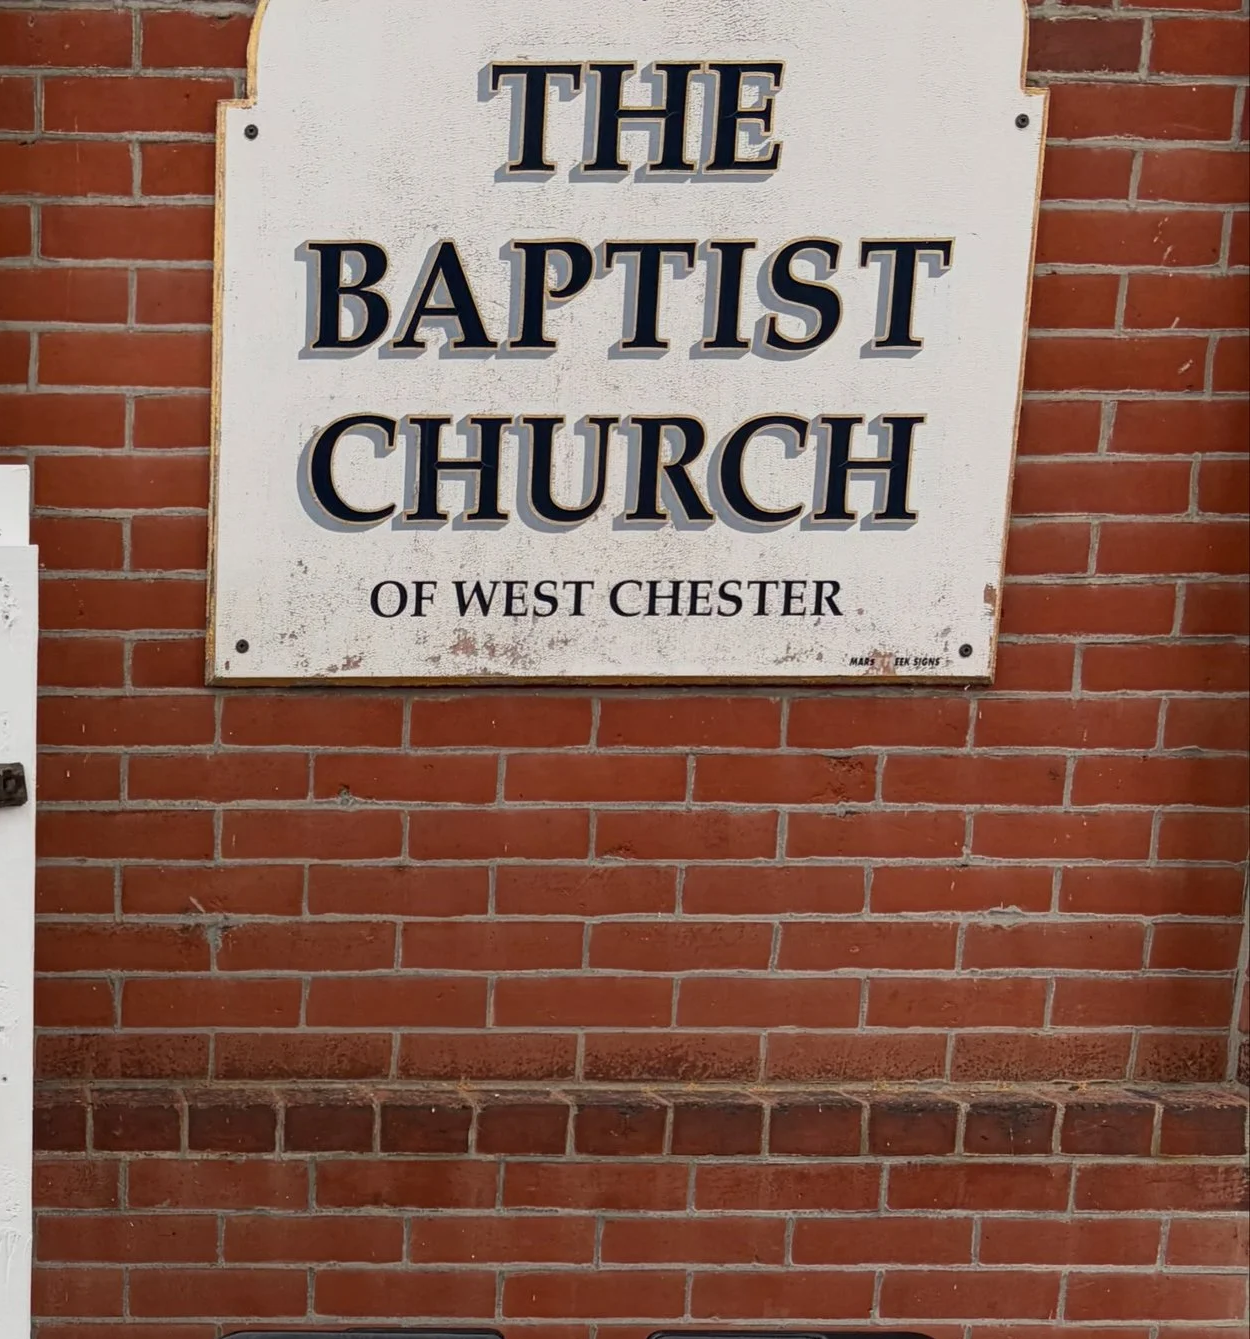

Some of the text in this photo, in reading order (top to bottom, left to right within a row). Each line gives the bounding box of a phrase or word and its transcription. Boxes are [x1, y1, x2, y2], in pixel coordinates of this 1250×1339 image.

[478, 60, 786, 183] THE
[295, 237, 954, 360] BAPTIST
[296, 412, 926, 532] CHURCH
[370, 579, 844, 619] OF WEST CHESTER
[913, 657, 940, 666] SIGNS
